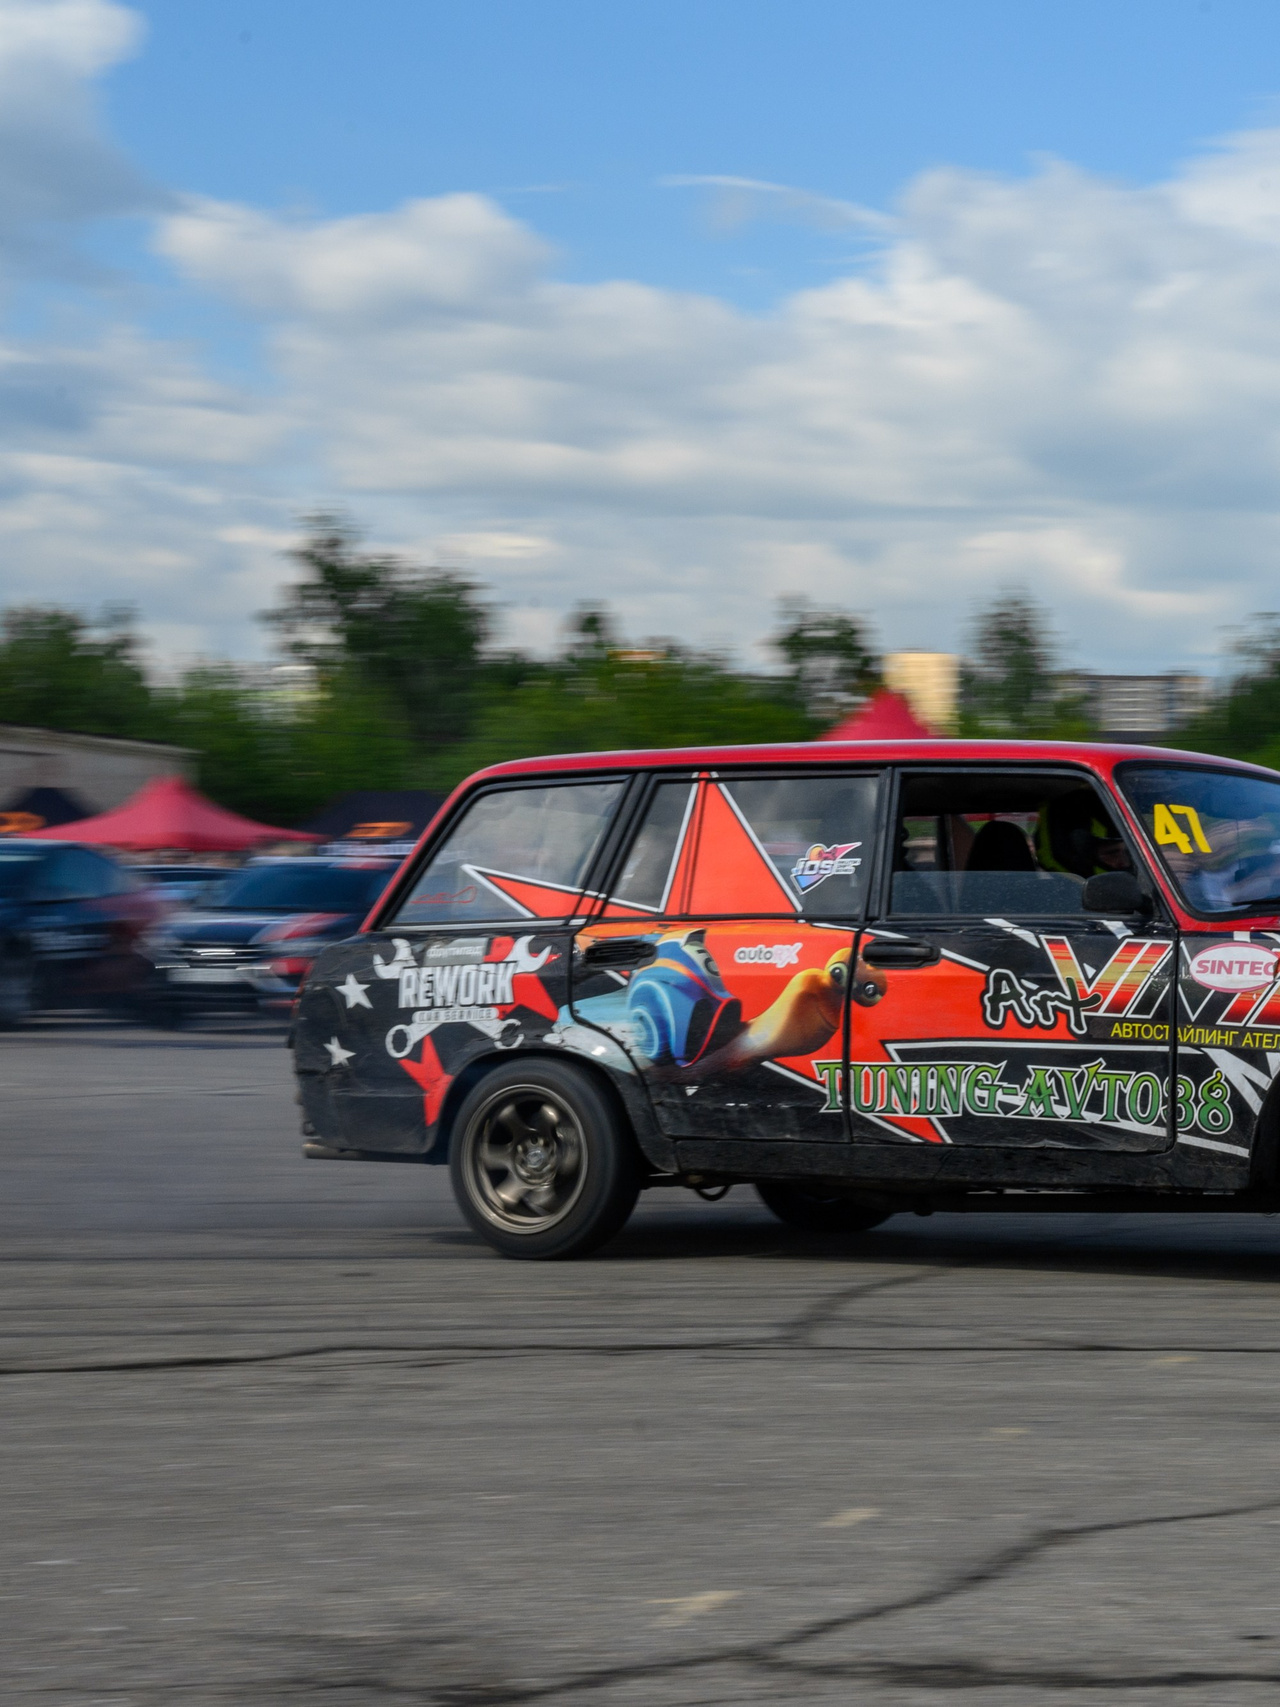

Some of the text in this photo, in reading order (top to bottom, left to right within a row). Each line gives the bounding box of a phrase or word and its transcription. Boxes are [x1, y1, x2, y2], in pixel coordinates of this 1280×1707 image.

[1154, 804, 1212, 854] 47
[1196, 959, 1275, 976] SINTEC
[398, 961, 518, 1009] REWORK
[444, 1008, 493, 1021] SERVICE
[1110, 1022, 1239, 1048] АВТОСТАЙЛИНГ
